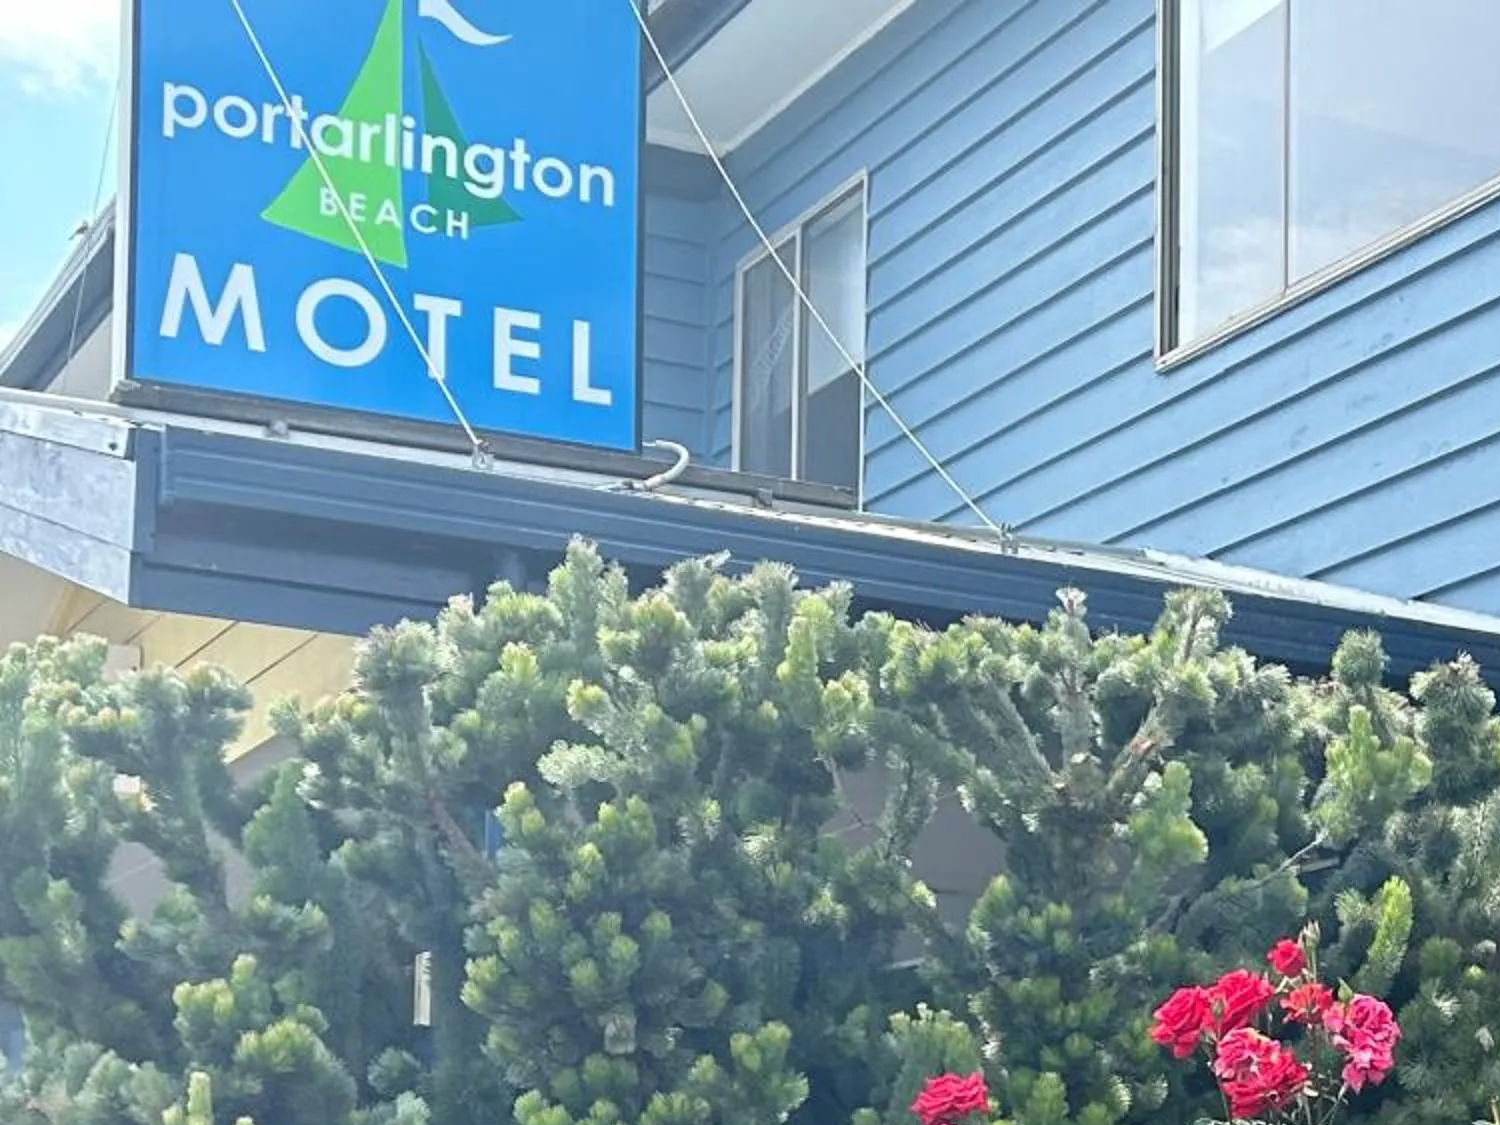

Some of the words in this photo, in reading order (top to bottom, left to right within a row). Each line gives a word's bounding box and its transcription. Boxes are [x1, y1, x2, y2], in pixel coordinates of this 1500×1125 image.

[162, 80, 615, 207] portarlington
[319, 187, 470, 240] BEACH
[159, 252, 613, 406] MOTEL
